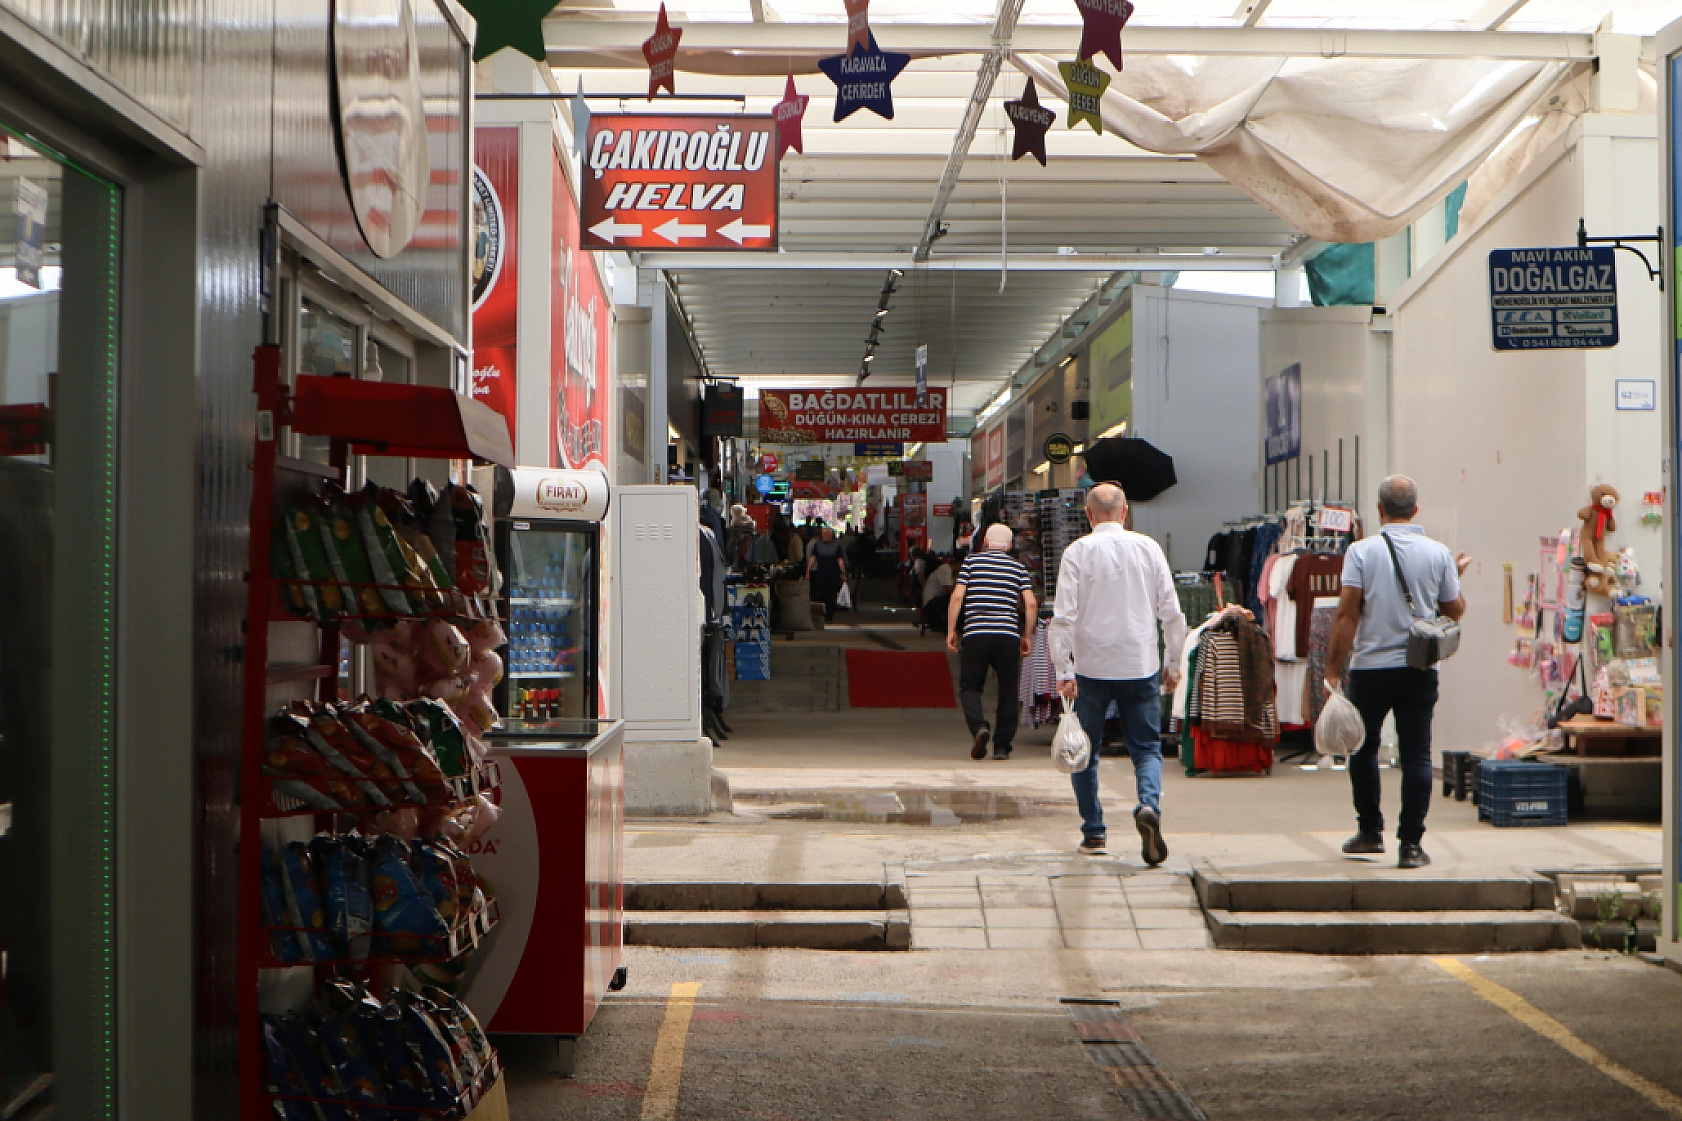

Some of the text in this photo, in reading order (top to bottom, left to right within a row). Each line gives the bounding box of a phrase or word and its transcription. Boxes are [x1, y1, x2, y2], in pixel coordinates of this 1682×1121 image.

[1070, 62, 1100, 87] DÜĞÜN
[841, 80, 885, 106] ÇEKİRDEK
[589, 124, 769, 179] ÇAKIROĞLU
[604, 183, 745, 210] HELVA
[1511, 248, 1593, 263] MAVİ AKIM
[1493, 262, 1613, 292] DOĞALGAZ
[795, 410, 941, 427] DÜĞÜN-KINA ÇEREZİ
[825, 427, 911, 439] HAZIRLANIR
[545, 485, 580, 499] FIRAT
[1323, 511, 1344, 526] 100
